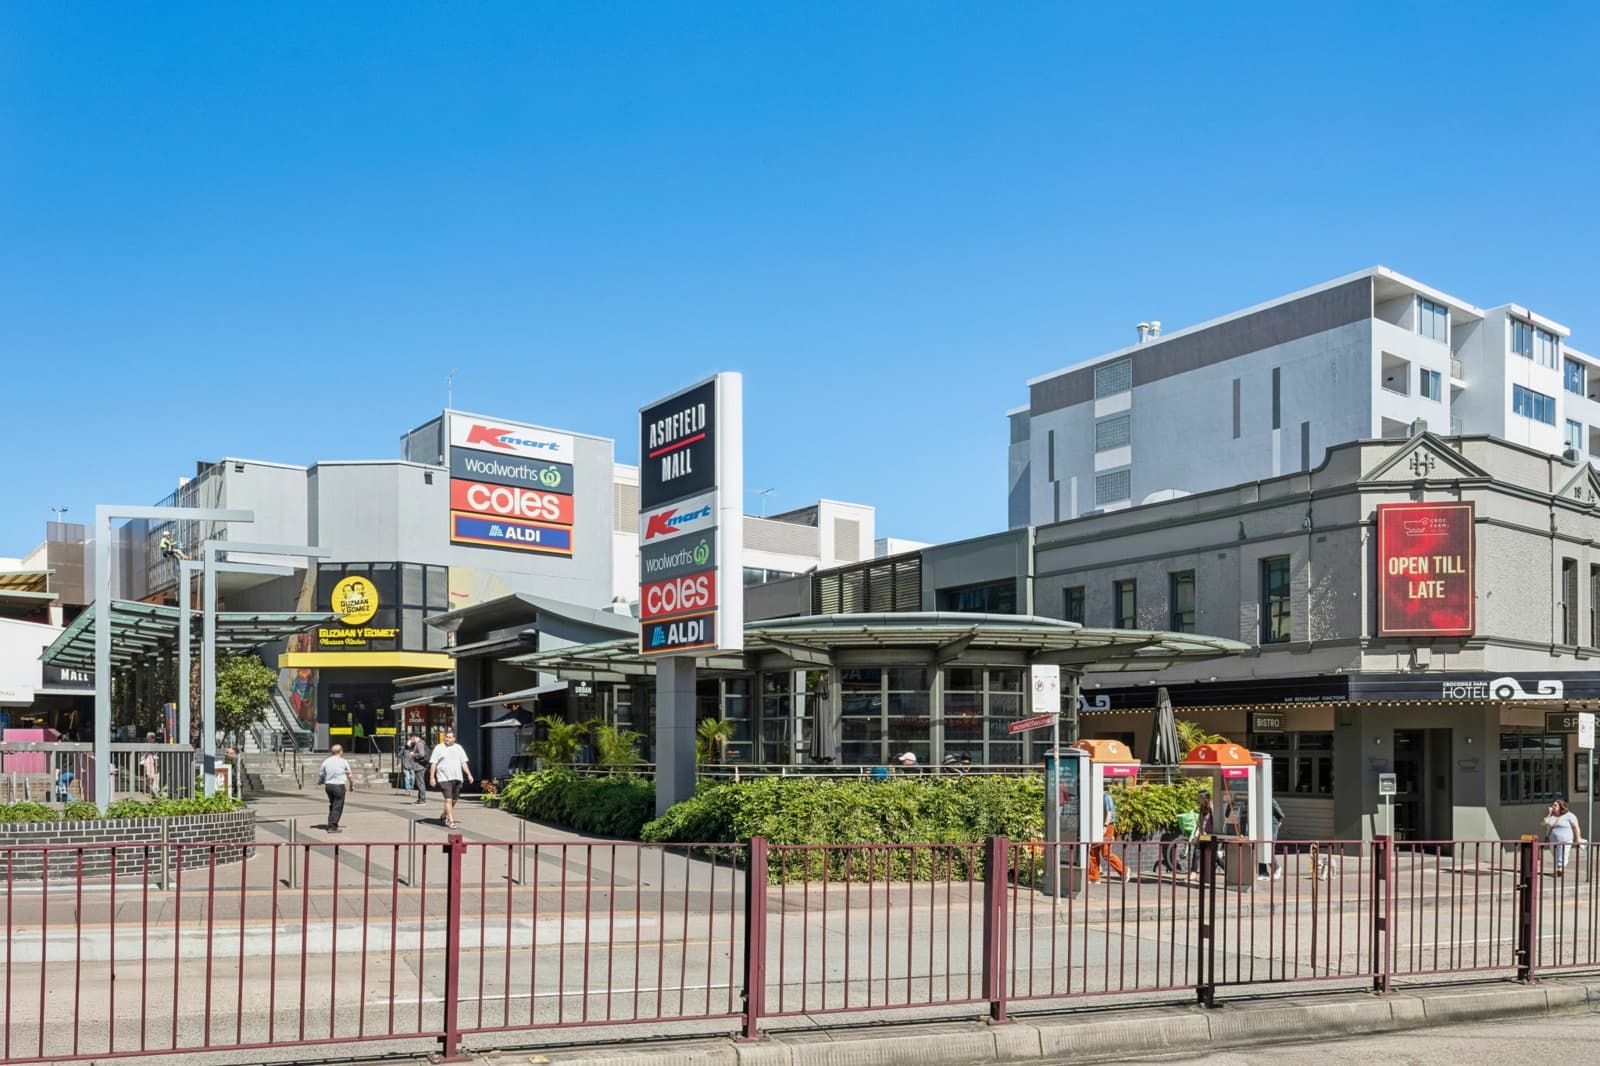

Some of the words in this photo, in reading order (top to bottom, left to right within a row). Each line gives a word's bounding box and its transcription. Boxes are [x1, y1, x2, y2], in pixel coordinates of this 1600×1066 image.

[649, 403, 705, 449] ASHFIELD
[466, 424, 560, 451] Kmart
[465, 457, 538, 481] Woolworths
[662, 448, 692, 482] MALL
[467, 485, 560, 520] coles
[645, 505, 711, 540] Kmart
[505, 527, 541, 542] ALDI
[646, 548, 693, 572] Woolworths
[1388, 556, 1429, 575] OPEN
[1433, 555, 1465, 574] TILL
[647, 576, 709, 614] coles
[1408, 580, 1446, 598] LATE
[340, 599, 369, 607] GUZMAN
[347, 605, 370, 613] GOMEZ
[319, 628, 356, 637] GUZMAN
[357, 629, 363, 637] Y
[364, 628, 396, 637] GOMEZ
[668, 619, 704, 645] ALDI
[61, 668, 89, 681] MALL
[1442, 686, 1488, 699] HOTEL
[1256, 718, 1280, 727] BISTRO
